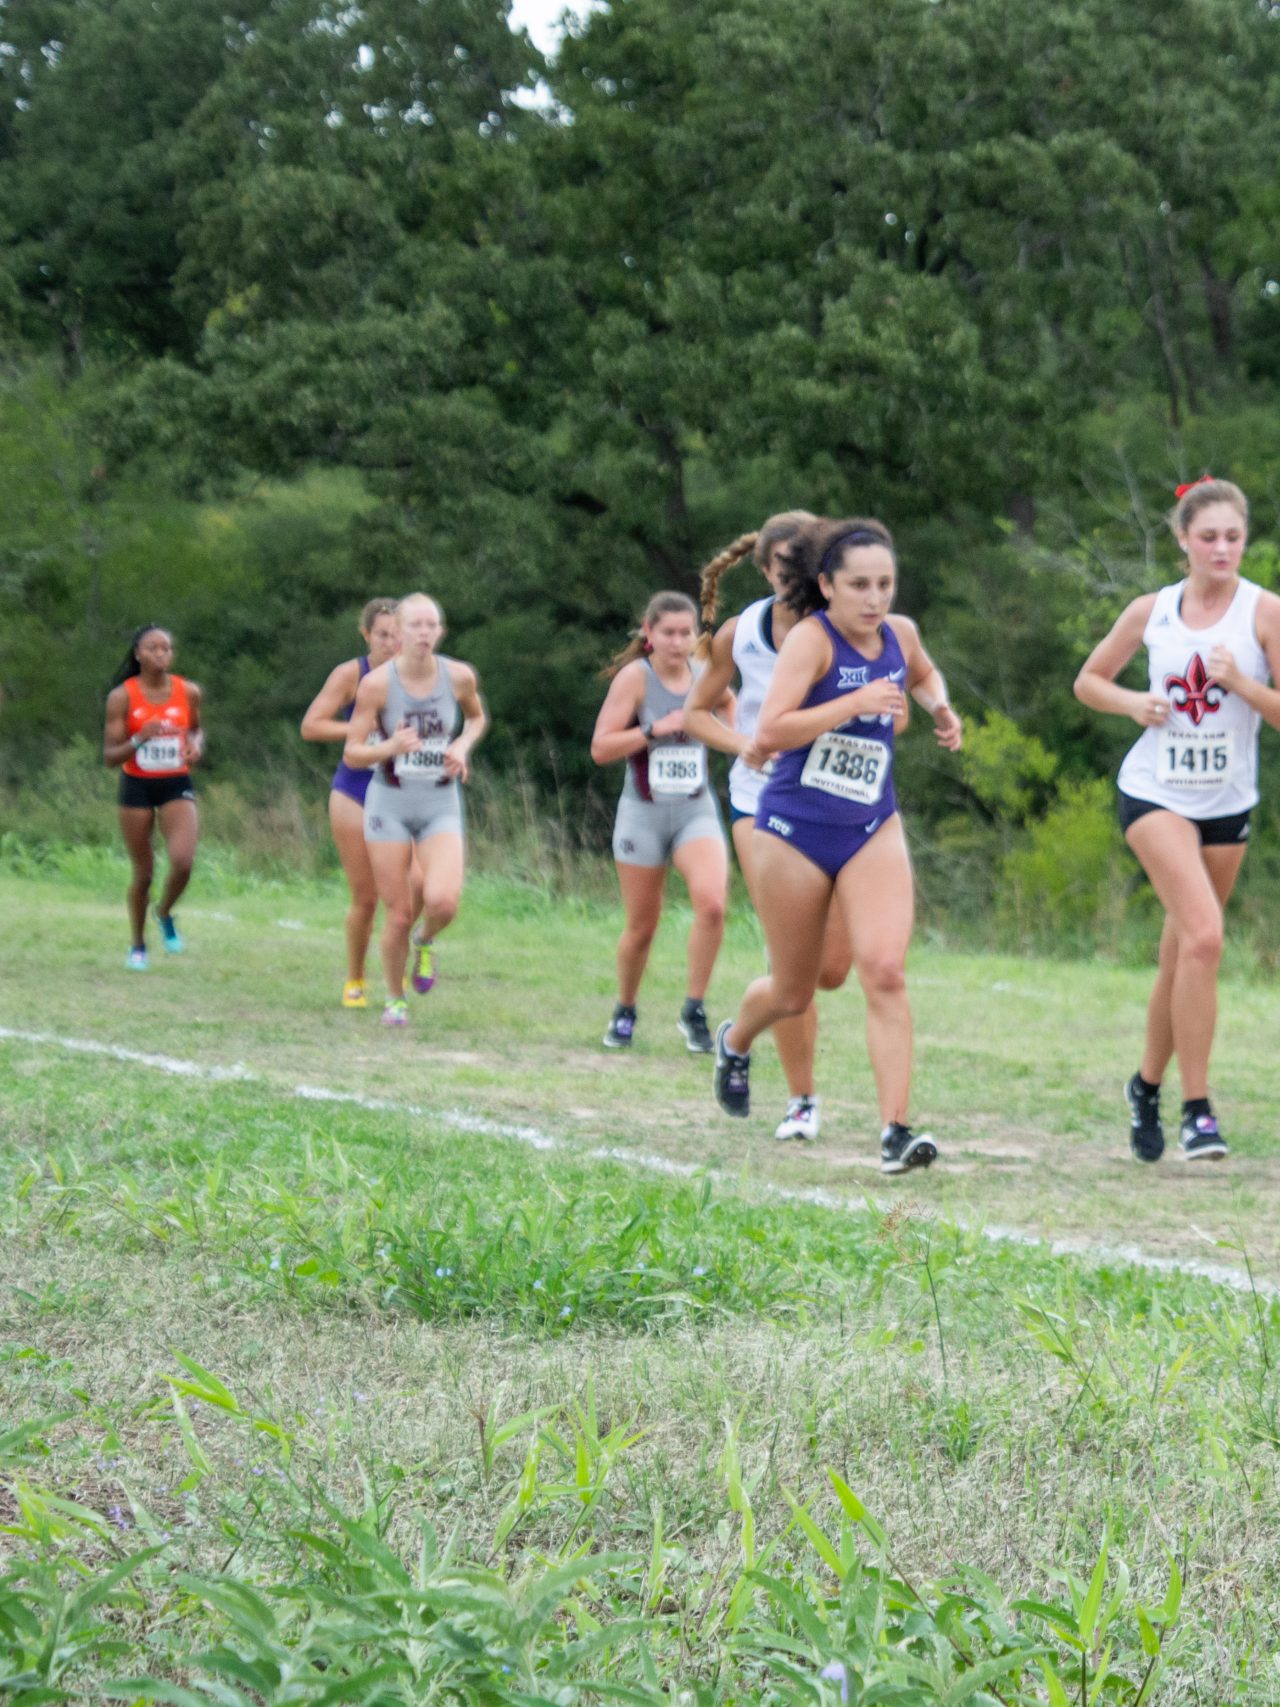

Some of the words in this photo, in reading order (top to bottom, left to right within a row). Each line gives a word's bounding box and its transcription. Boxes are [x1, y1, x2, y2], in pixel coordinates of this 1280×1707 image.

[818, 747, 879, 785] 1386
[1166, 745, 1227, 773] 1415
[767, 815, 793, 837] TCU
